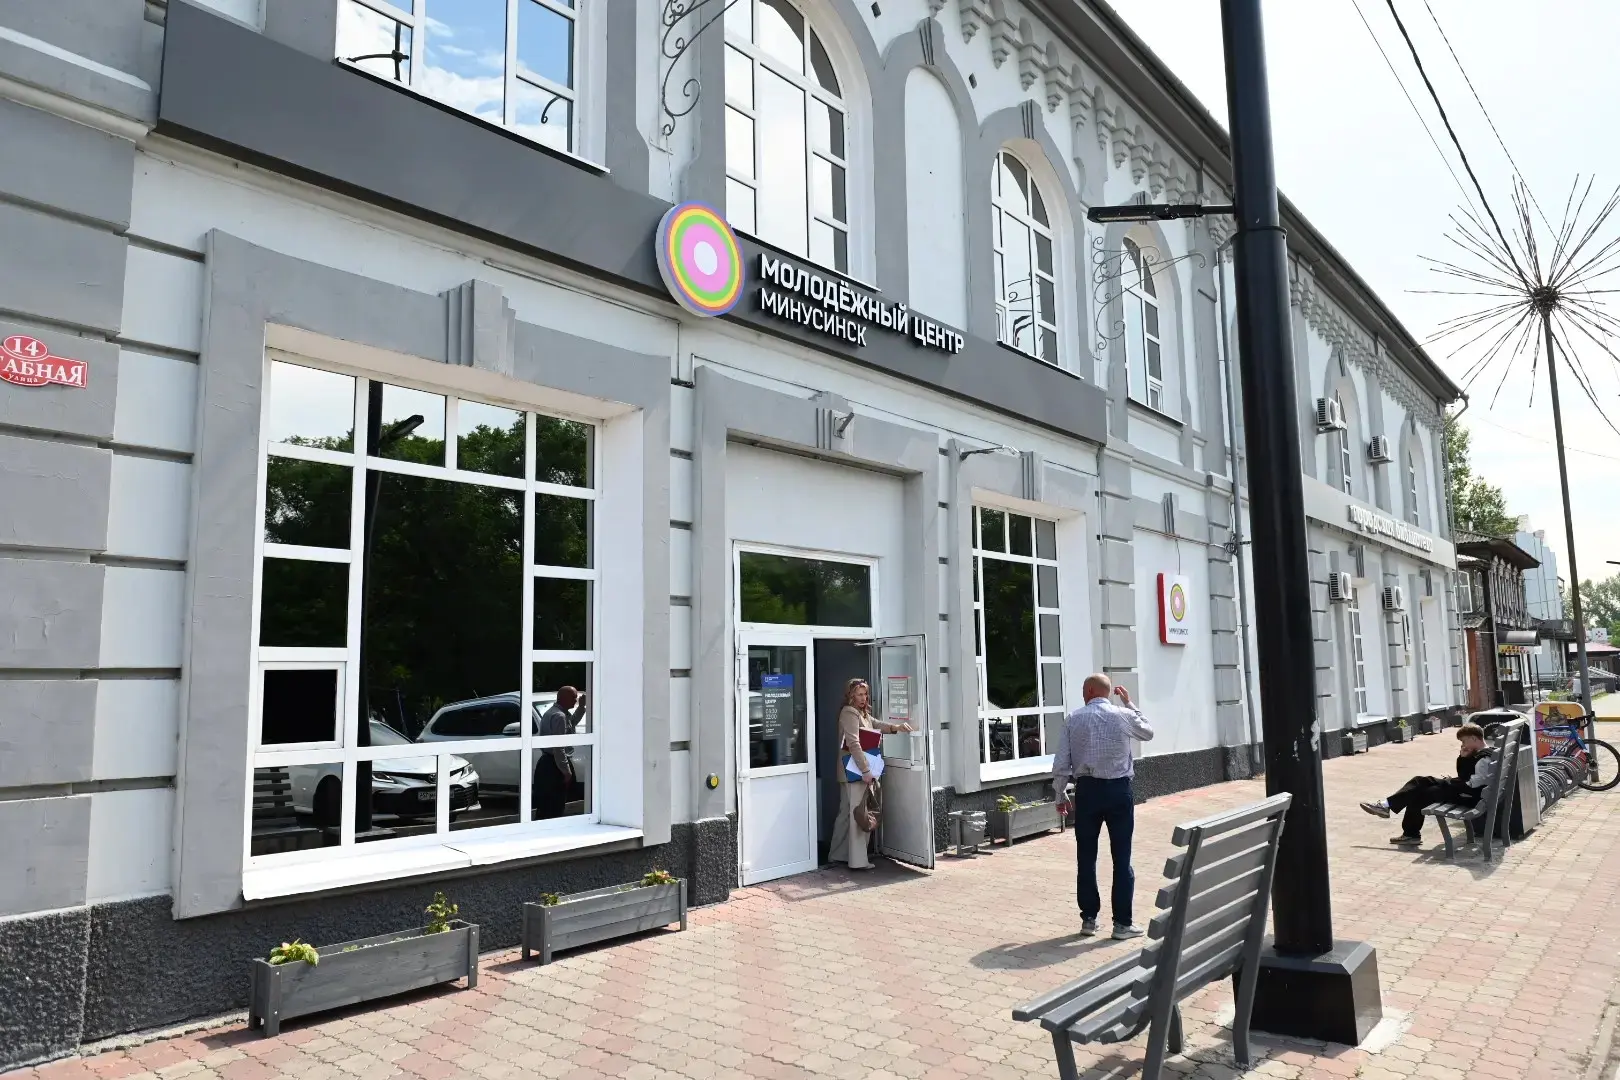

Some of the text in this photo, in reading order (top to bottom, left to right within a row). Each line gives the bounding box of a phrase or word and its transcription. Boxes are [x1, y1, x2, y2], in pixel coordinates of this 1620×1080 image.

[760, 253, 965, 354] МОЛОДЁЖНЫЙ ЦЕНТР
[760, 287, 867, 347] МИНУСИНСК
[13, 338, 39, 357] 14
